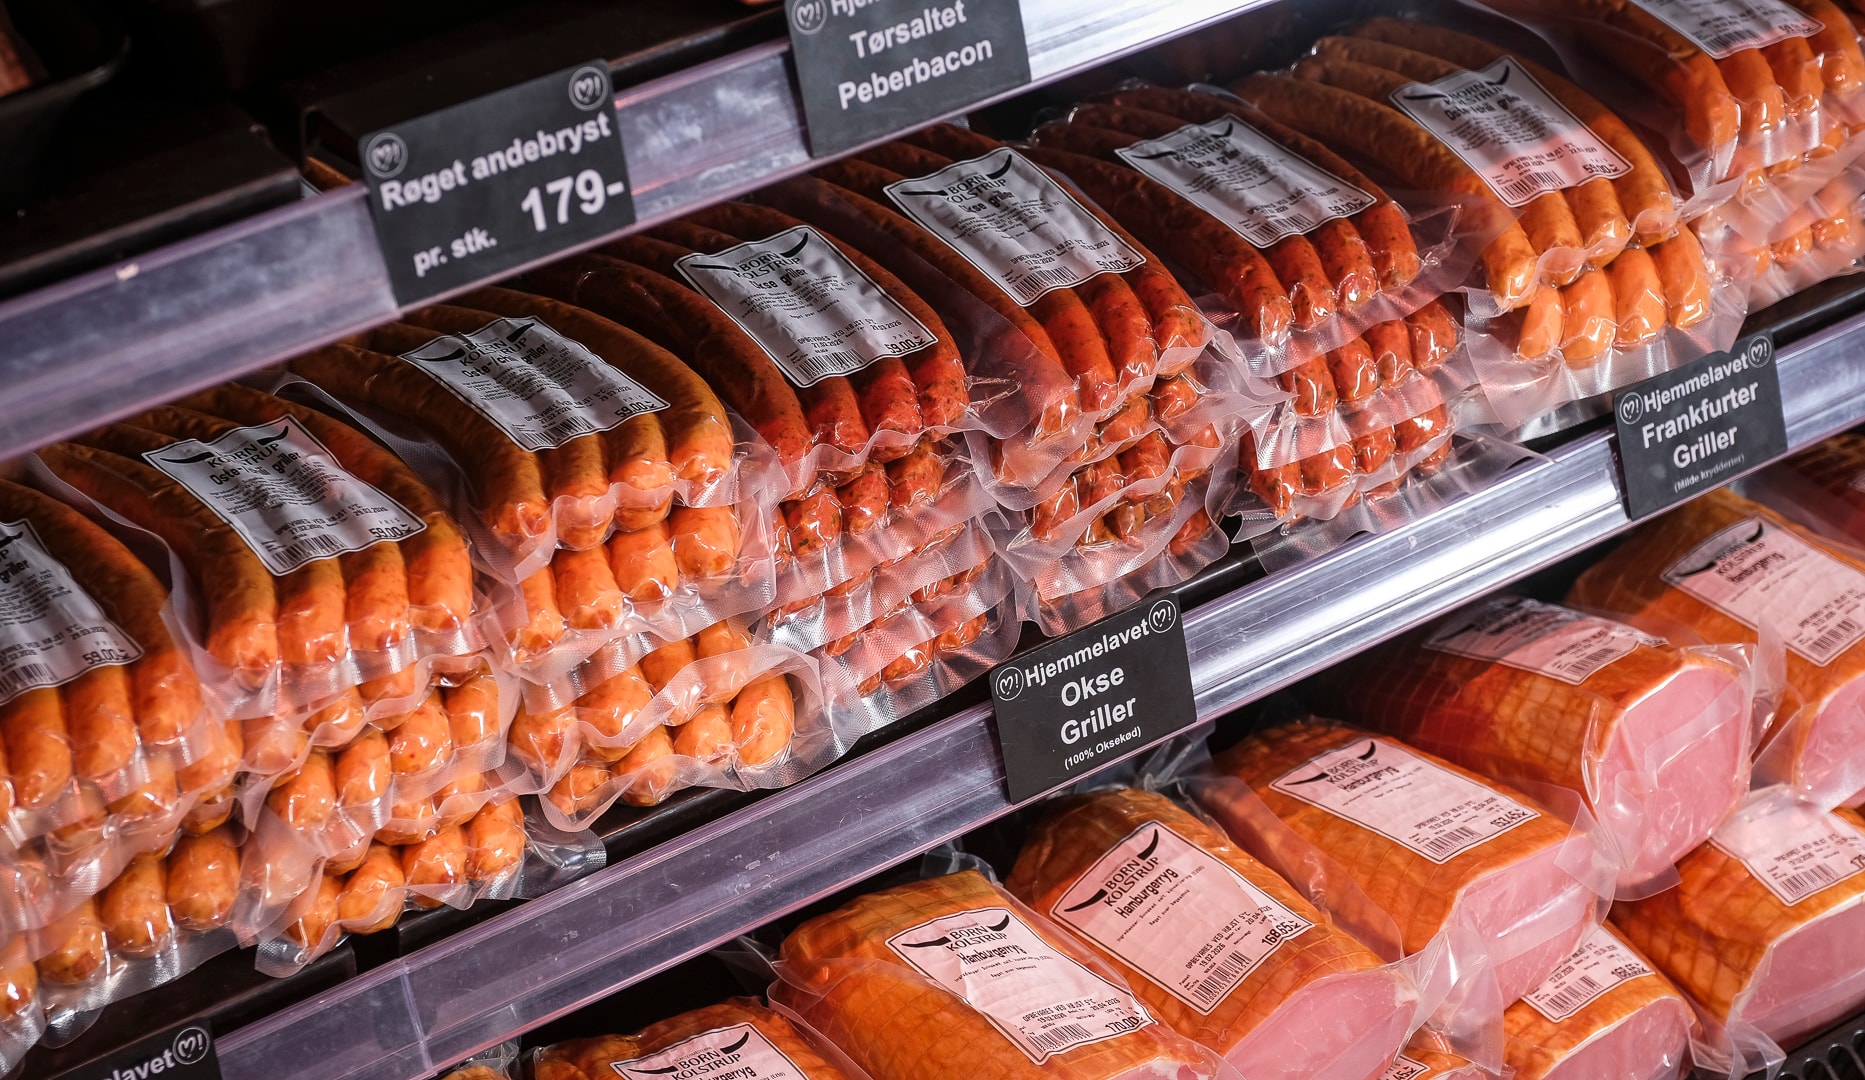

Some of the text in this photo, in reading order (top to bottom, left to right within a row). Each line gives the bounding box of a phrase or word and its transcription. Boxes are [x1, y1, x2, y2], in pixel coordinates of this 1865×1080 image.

[849, 2, 968, 59] Tørsaltet
[838, 39, 993, 110] Peberbacon
[378, 111, 611, 212] Røget andebryst
[948, 174, 988, 194] BORN
[413, 168, 625, 277] pr. stk. 179-
[738, 253, 780, 271] BORN
[1644, 352, 1750, 413] Hjemmelavet
[1641, 380, 1759, 449] Frankfurter
[1673, 425, 1738, 469] Griller
[1674, 453, 1745, 494] (Milde krydderier)
[1024, 618, 1150, 687] Hjemmelavet
[1061, 667, 1125, 707] Okse
[1060, 697, 1137, 745] Griller
[1064, 726, 1142, 771] (100% Oksekød)
[1103, 856, 1160, 907] KOLSTRUP
[1105, 859, 1141, 890] BORN
[1114, 868, 1179, 919] Hamburgerryg
[945, 932, 1008, 952] KOLSTRUP
[950, 925, 989, 940] BORN
[1185, 943, 1213, 970] OPBEVARES
[1212, 933, 1224, 943] VED
[1222, 918, 1240, 934] HØJST
[1199, 943, 1226, 968] 19.02.2026
[1104, 1016, 1140, 1033] 170.00
[670, 1053, 741, 1080] KOLSTRUP
[678, 1050, 721, 1070] BORN
